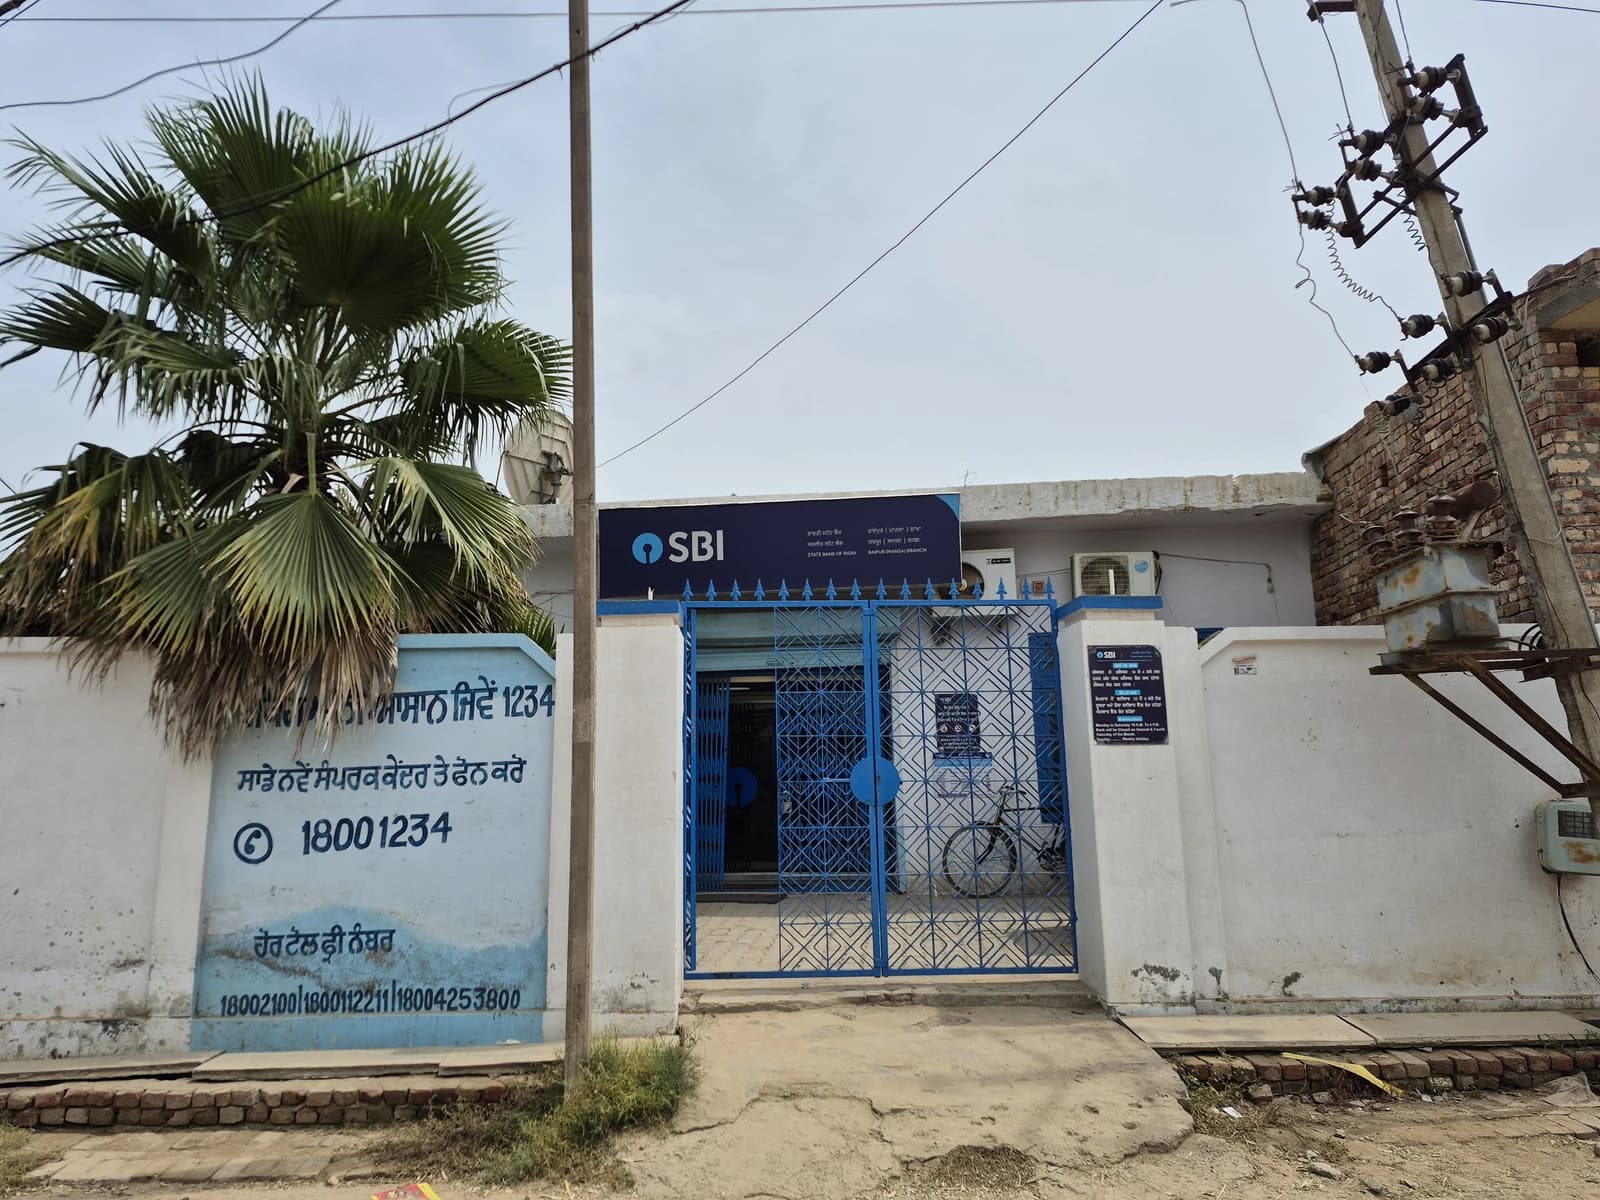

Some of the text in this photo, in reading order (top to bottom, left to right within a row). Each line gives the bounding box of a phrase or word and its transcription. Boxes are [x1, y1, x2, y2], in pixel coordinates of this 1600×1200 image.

[667, 529, 724, 563] SBI
[1103, 651, 1116, 659] SBI
[451, 675, 498, 722] ਜਿਵੇਂ
[502, 684, 556, 718] 1234
[237, 762, 277, 792] ਸਾਡੇ
[278, 760, 313, 793] ਨਵੇਂ
[314, 759, 381, 791] ਸੰਪਰਕ
[382, 753, 431, 790] ਕੇਂਦਰ
[433, 754, 449, 787] ਤੇ
[491, 753, 527, 784] ਕਰੋ
[254, 928, 285, 958] ਹੋਰ
[285, 925, 320, 956] ਟੋਲ
[348, 923, 396, 954] ਨੰਬਰ
